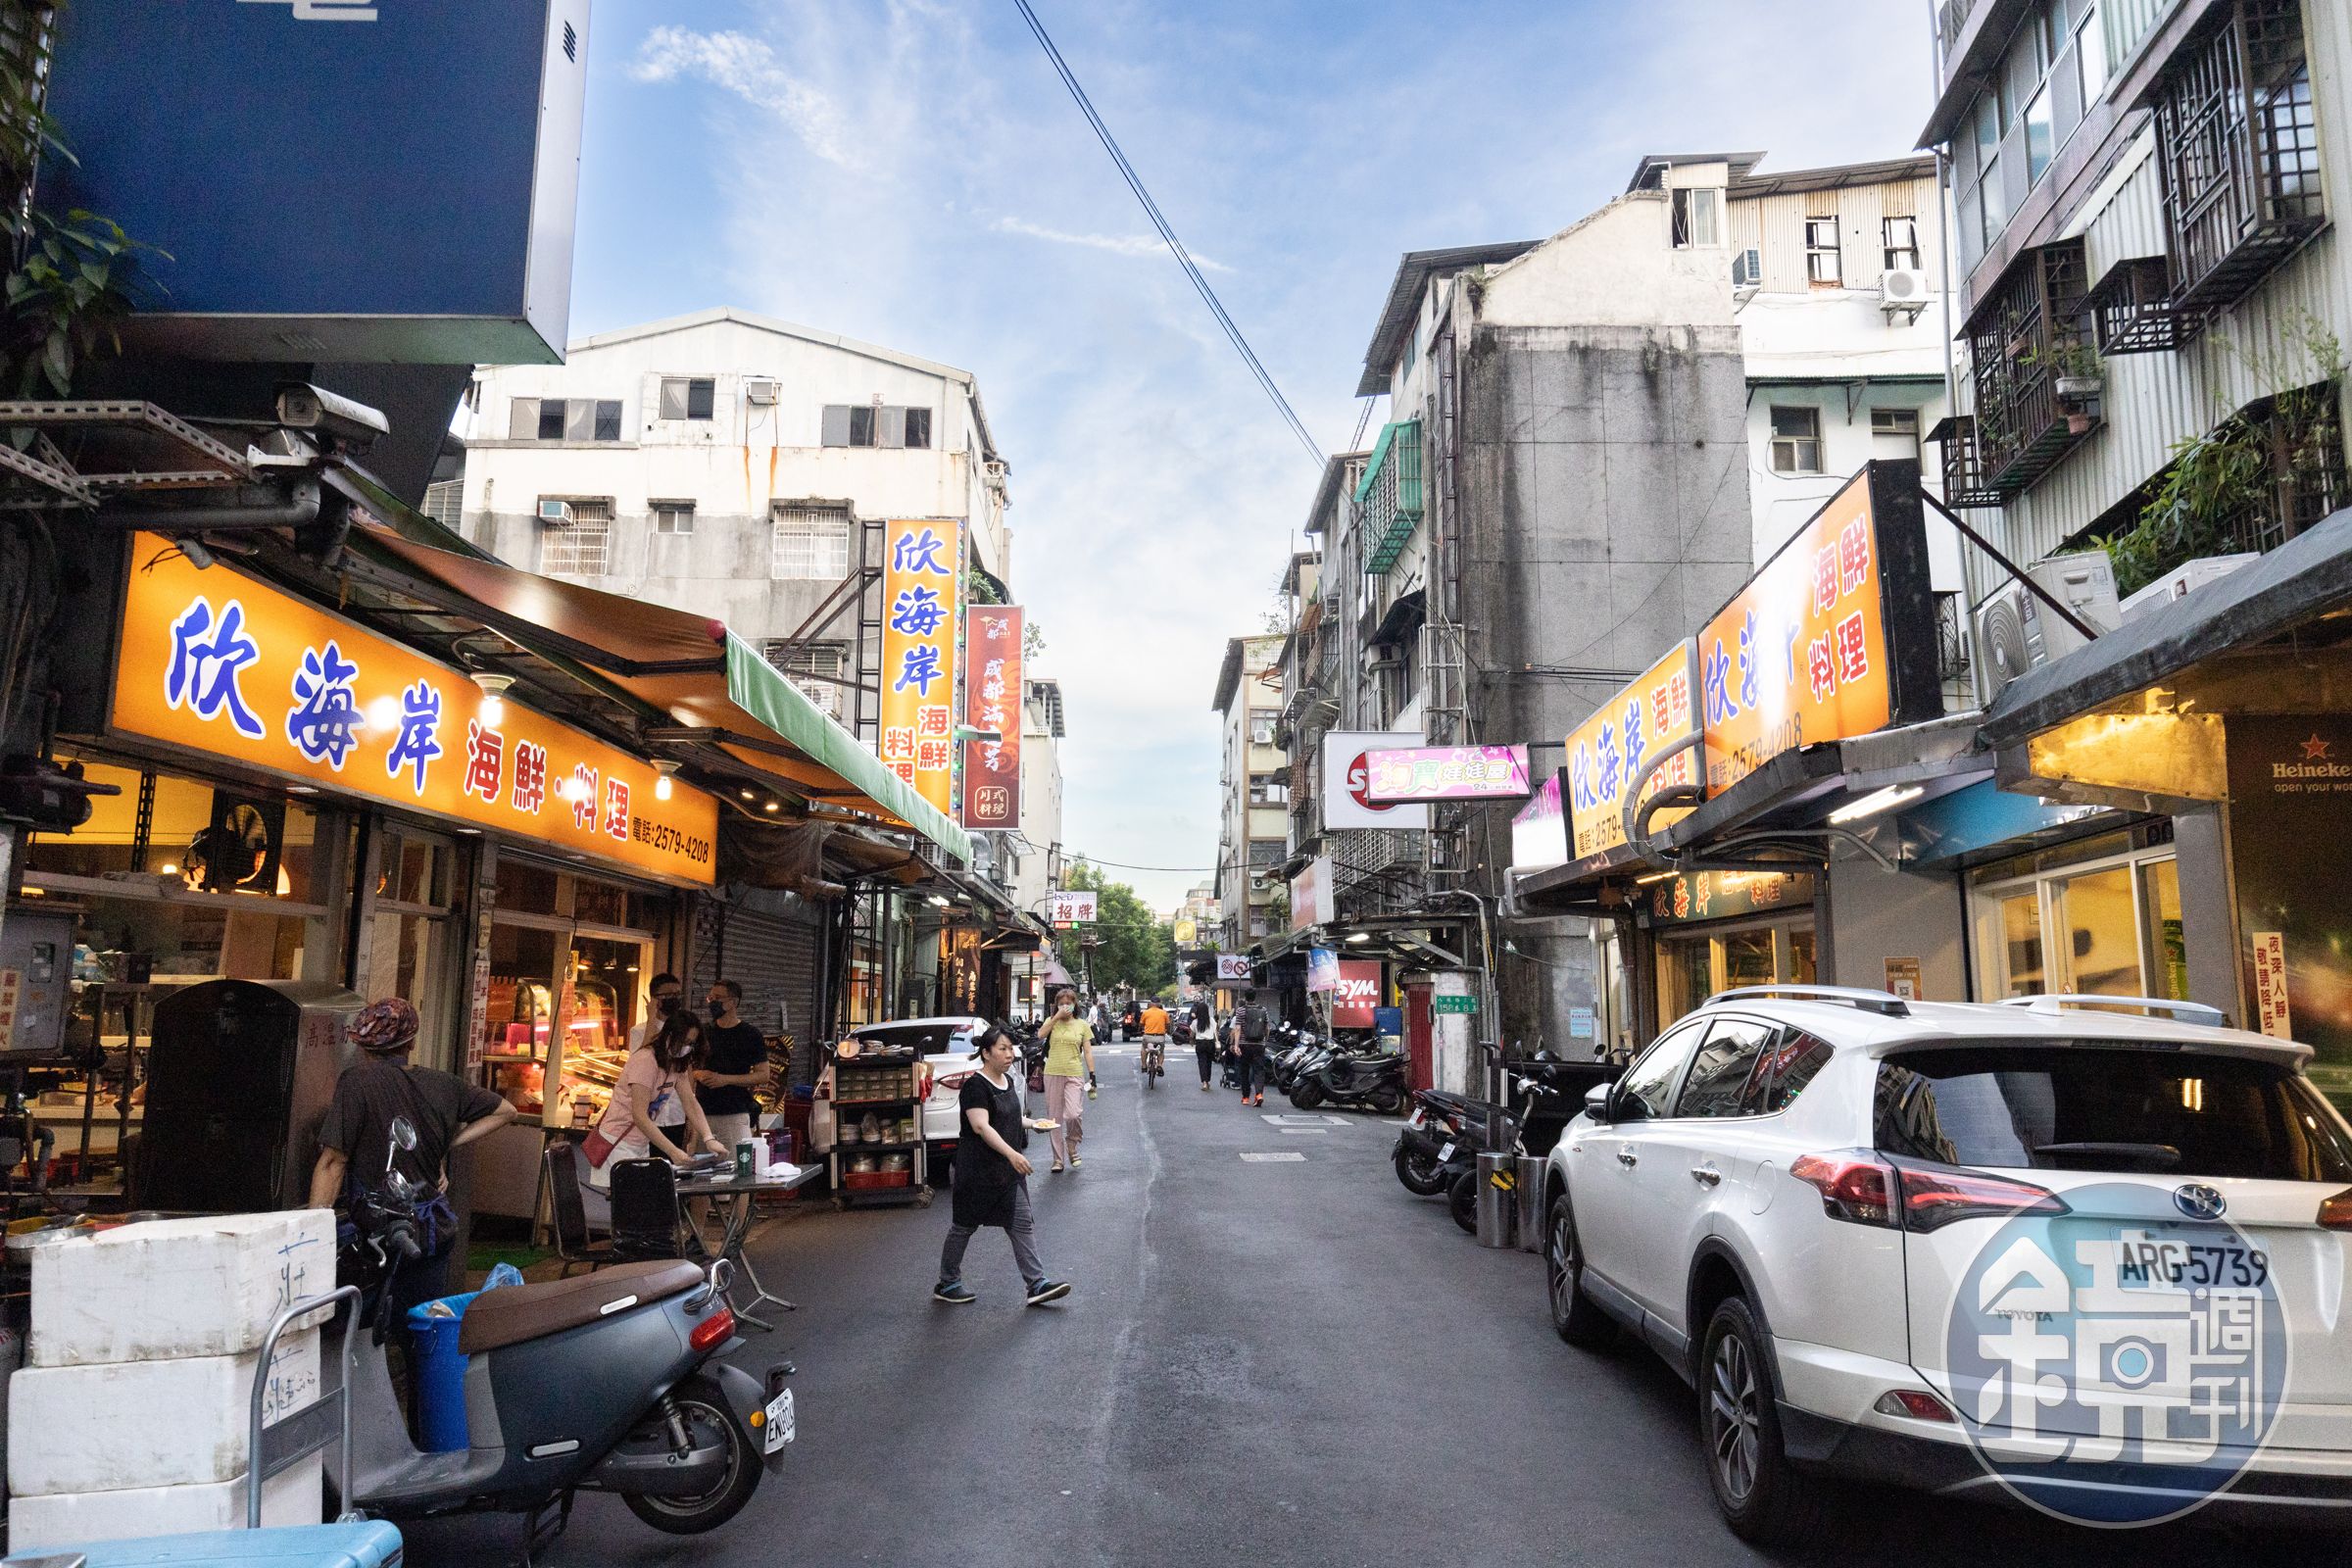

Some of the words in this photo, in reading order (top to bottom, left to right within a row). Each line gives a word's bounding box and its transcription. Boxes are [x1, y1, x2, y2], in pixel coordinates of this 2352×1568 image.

[1813, 514, 1870, 615] 海鮮
[893, 528, 952, 696] 欣海岸
[1809, 612, 1868, 702] 料理
[168, 599, 444, 795] 欣海岸
[1650, 668, 1689, 739] 海鮮
[919, 707, 949, 769] 海鮮
[1573, 699, 1645, 812] 欣海岸
[2273, 762, 2352, 778] Heineke
[2275, 784, 2303, 793] open
[2306, 784, 2330, 794] your
[632, 816, 710, 864] 電話:2579-4208
[1056, 902, 1094, 920] 招牌
[1653, 870, 1712, 919] 欣海岸
[1339, 979, 1379, 1001] SYM
[2256, 947, 2275, 1037] 敬請降低
[2268, 936, 2286, 1019] 夜深人靜
[1995, 1308, 2053, 1322] TOYOTA
